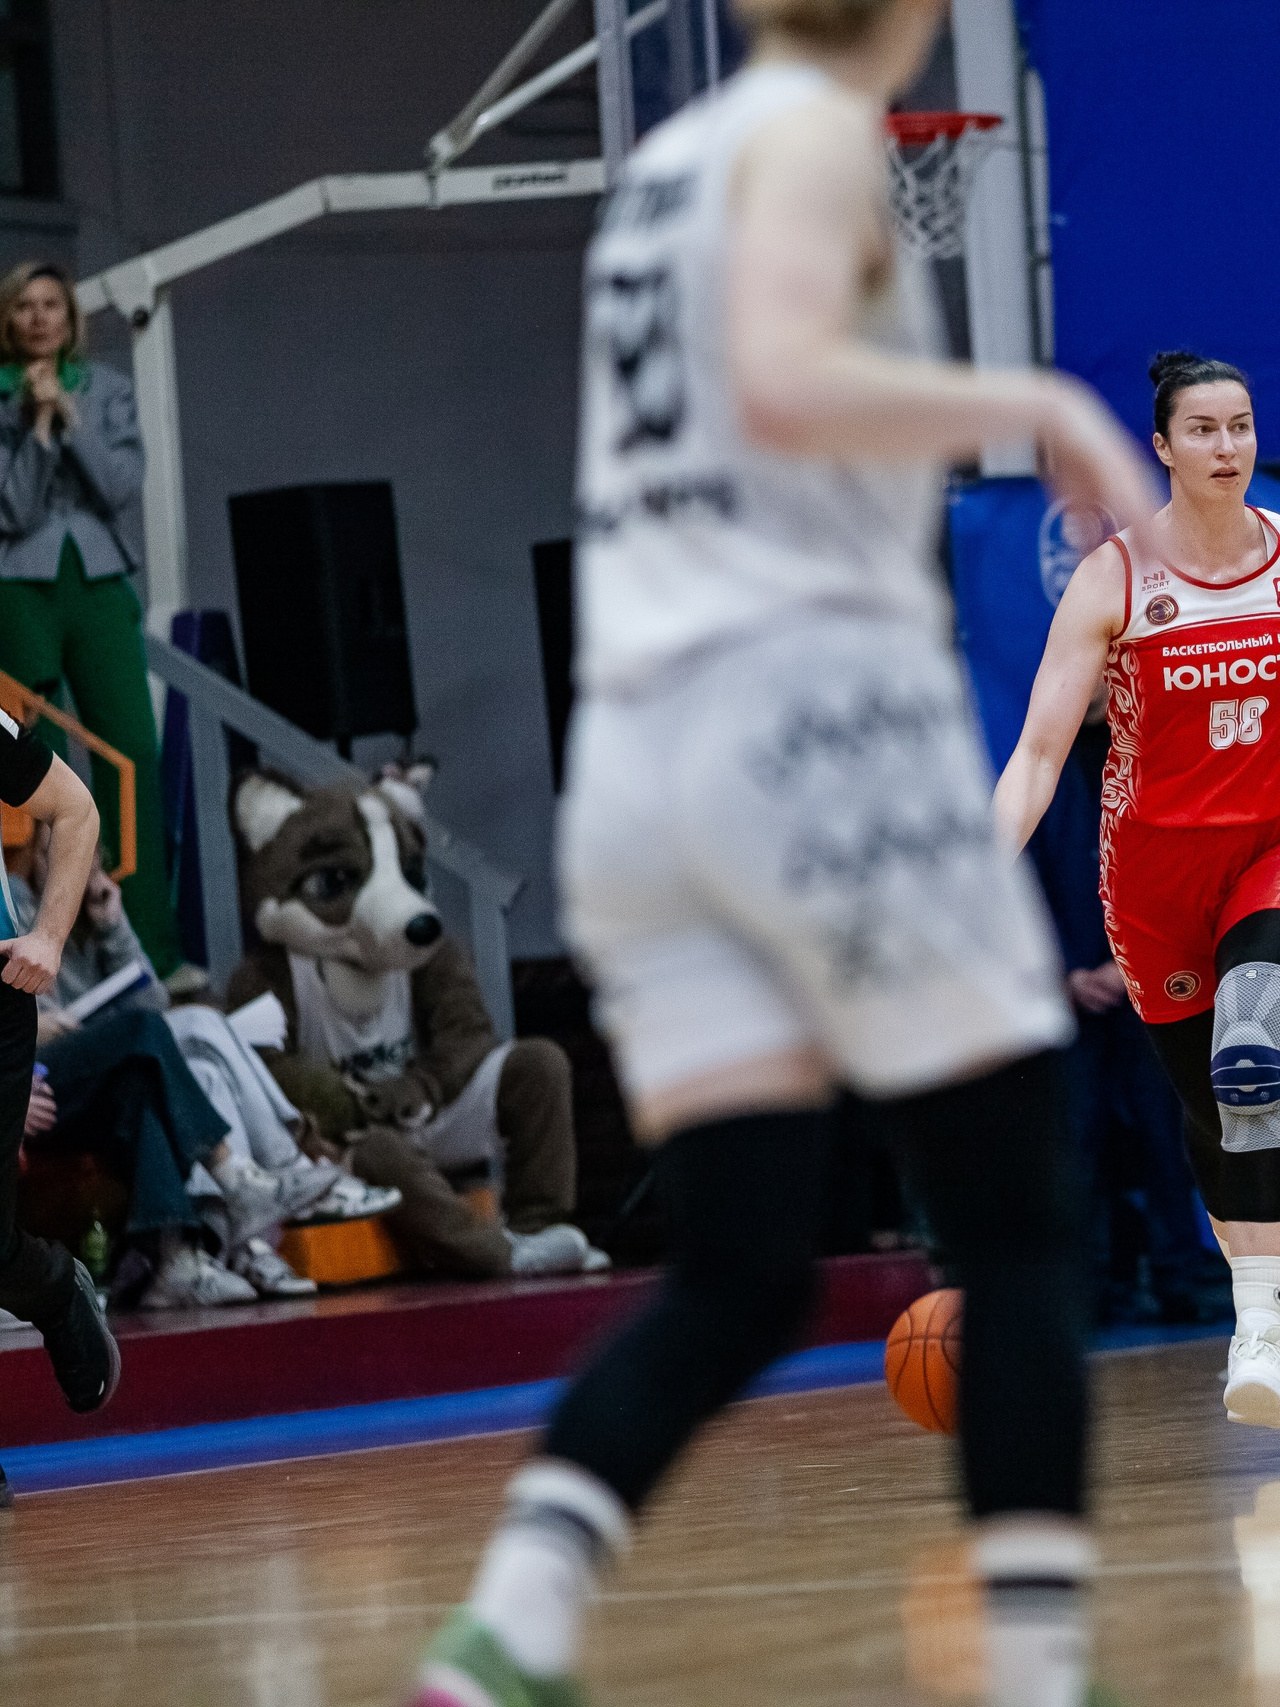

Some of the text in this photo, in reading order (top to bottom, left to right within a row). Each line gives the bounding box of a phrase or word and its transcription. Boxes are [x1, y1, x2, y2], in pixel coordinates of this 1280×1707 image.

[1141, 580, 1170, 592] SPORT
[1162, 634, 1273, 657] БАСКЕТБОЛЬНЫЙ
[1209, 696, 1269, 750] 58
